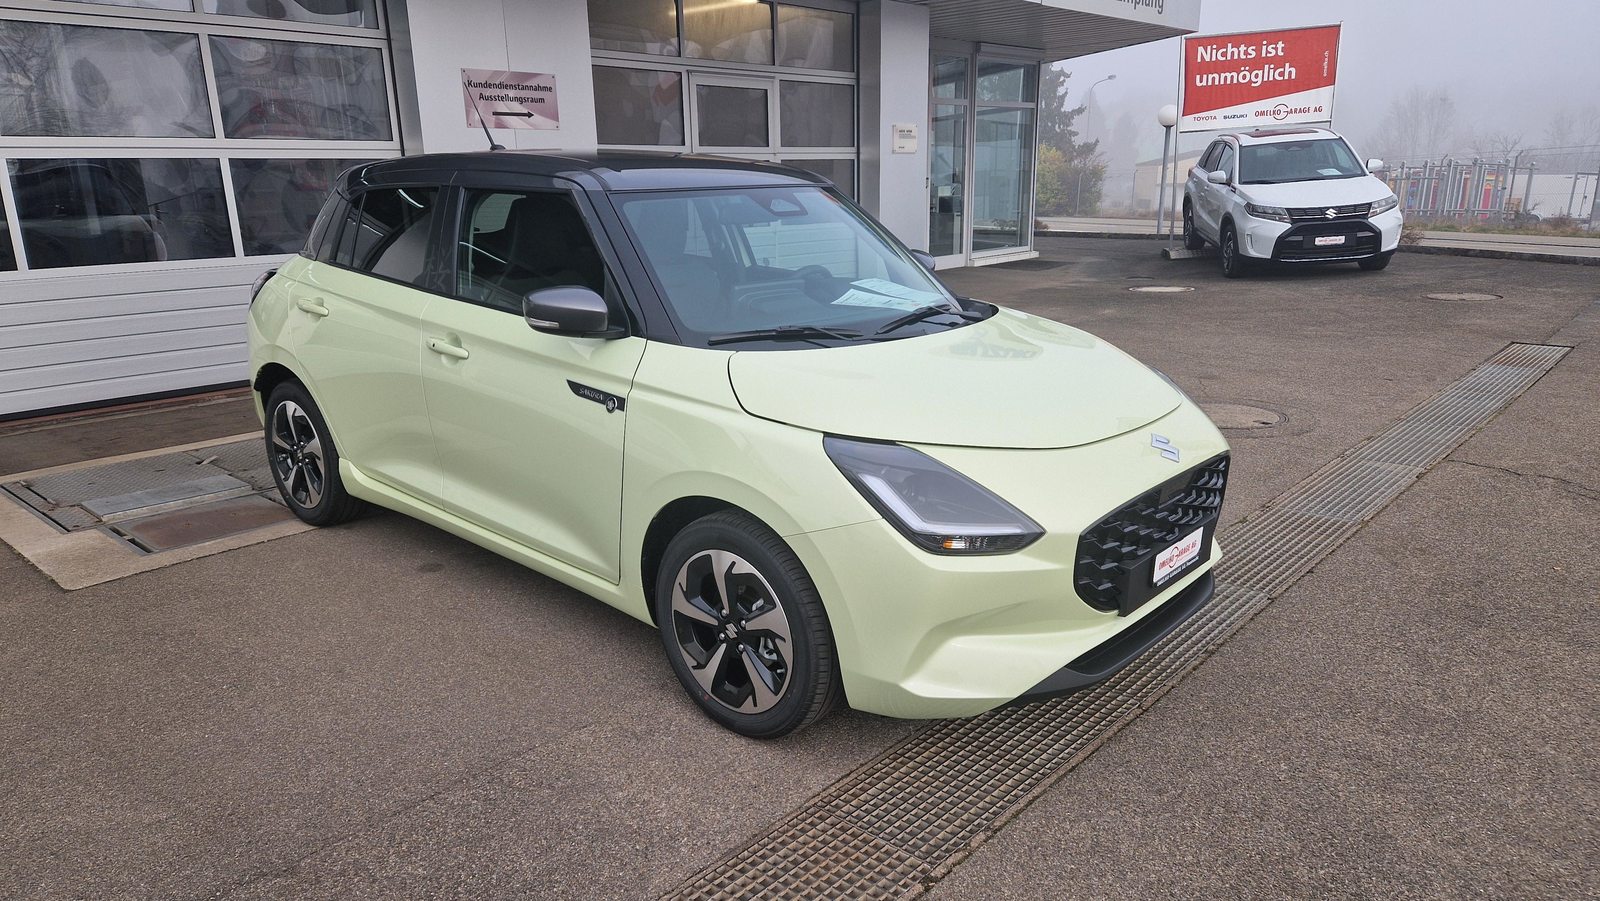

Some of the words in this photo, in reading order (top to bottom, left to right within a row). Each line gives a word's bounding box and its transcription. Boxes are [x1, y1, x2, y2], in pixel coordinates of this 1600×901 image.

[1197, 43, 1256, 63] Nichts
[1261, 40, 1285, 58] ist
[1195, 62, 1296, 87] unmöglich
[467, 79, 553, 93] Kundendienstannahme
[478, 93, 545, 104] Ausstellungsraum
[1254, 108, 1282, 118] OMELKO
[1313, 105, 1323, 113] AG
[579, 388, 603, 401] SAKURA
